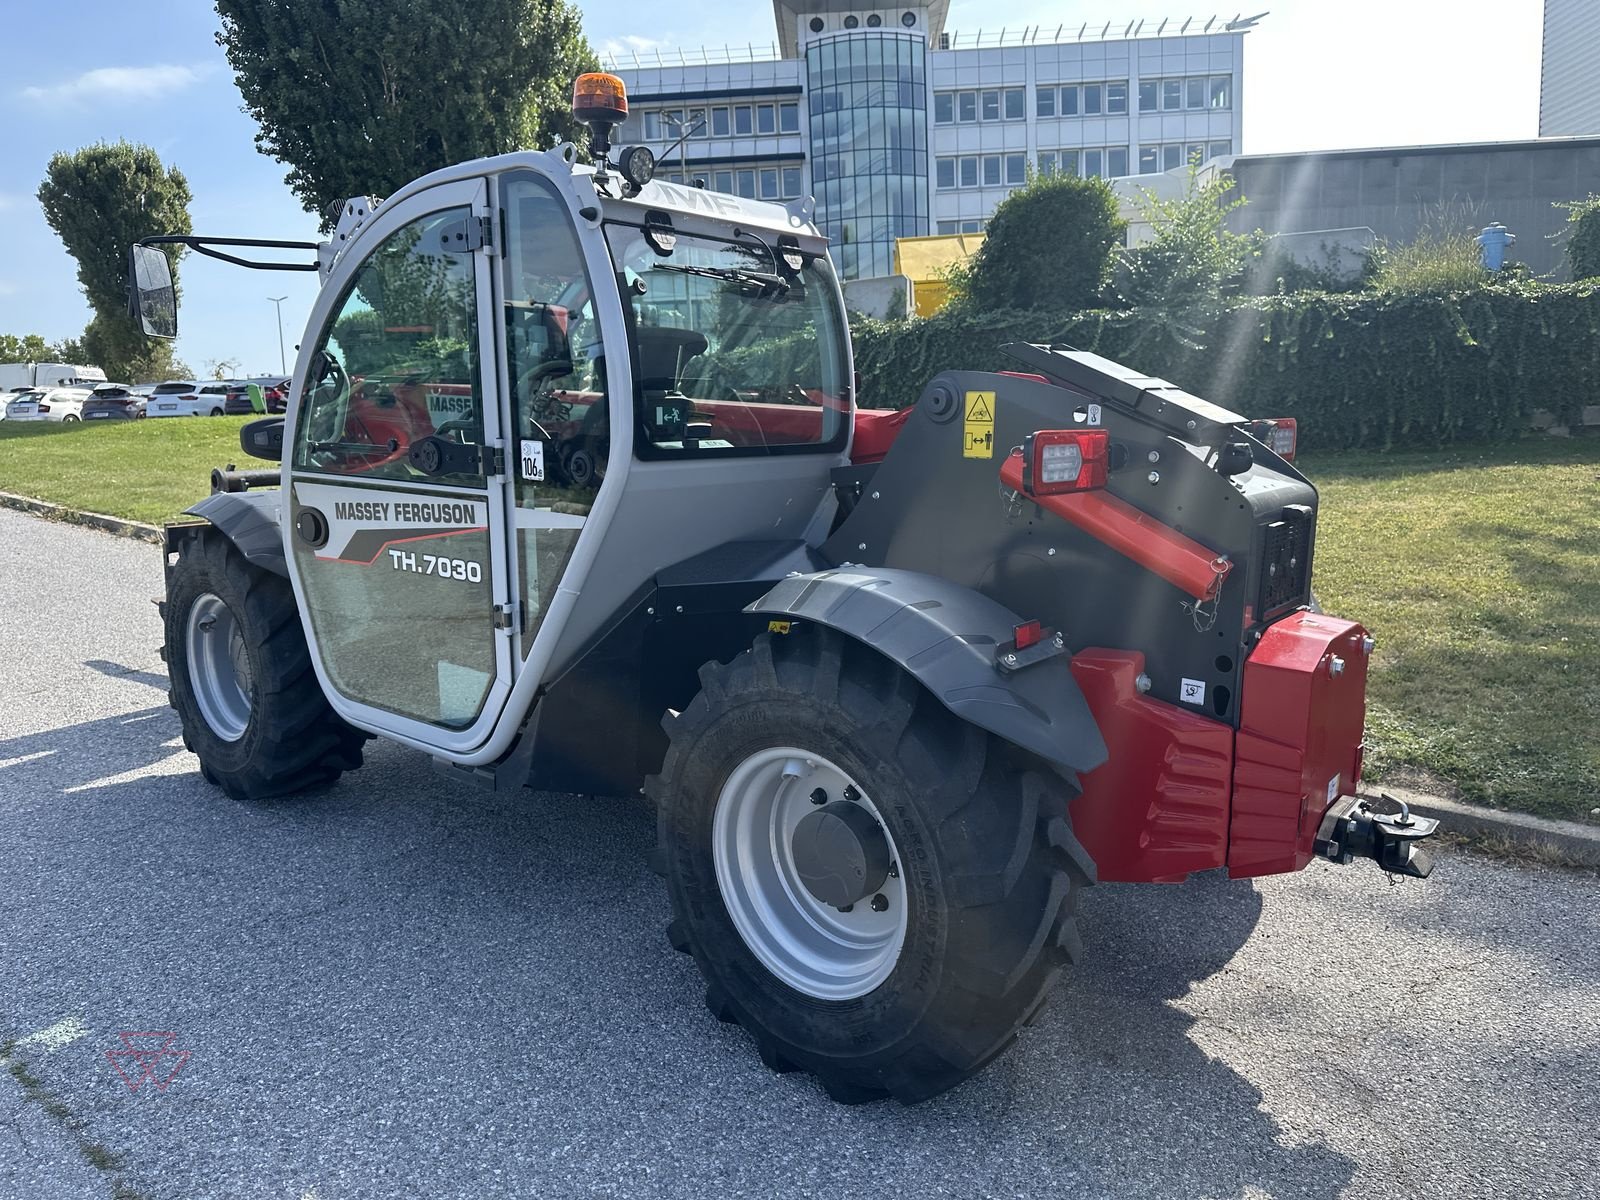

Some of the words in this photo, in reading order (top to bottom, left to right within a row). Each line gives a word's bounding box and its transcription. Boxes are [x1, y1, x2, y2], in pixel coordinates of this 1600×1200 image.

[657, 183, 741, 215] MF
[523, 457, 538, 476] 106
[335, 502, 389, 521] MASSEY
[394, 503, 476, 524] FERGUSON
[388, 549, 482, 583] TH.7030
